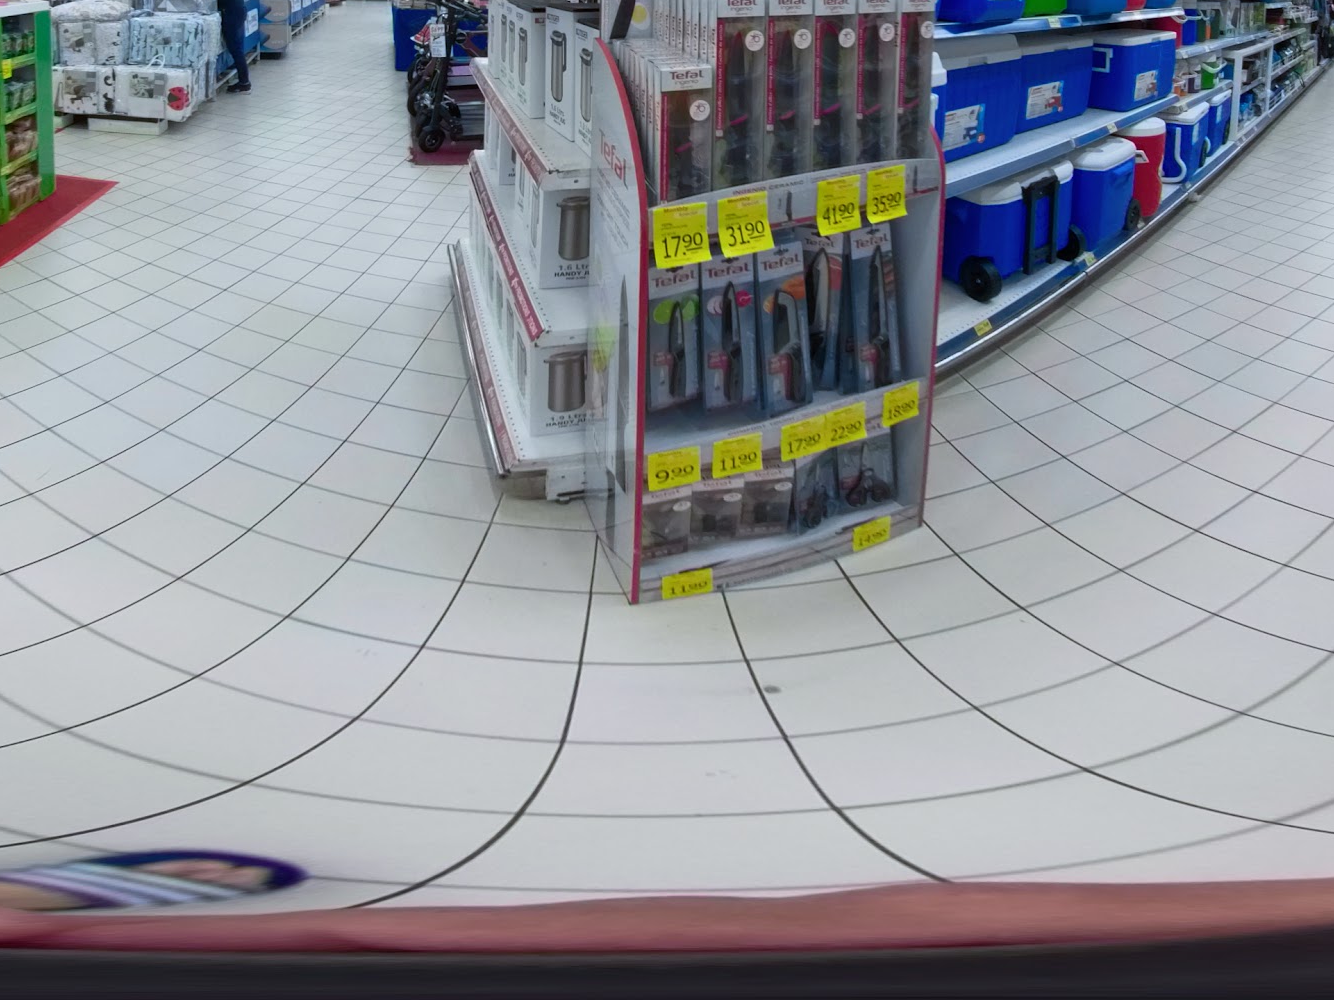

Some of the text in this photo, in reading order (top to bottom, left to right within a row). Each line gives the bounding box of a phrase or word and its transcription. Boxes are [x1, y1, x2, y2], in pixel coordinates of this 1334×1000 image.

[669, 70, 704, 80] Tefal
[598, 128, 629, 191] Tefal
[822, 201, 855, 226] 41.90
[871, 191, 902, 215] 35.90
[725, 220, 765, 248] 31.90
[854, 233, 889, 249] Tefal
[661, 231, 704, 260] 17.90
[705, 262, 752, 278] Tefal
[760, 252, 801, 271] Tefal
[554, 270, 582, 278] HANDY
[652, 270, 696, 289] Tefal
[545, 418, 573, 428] HANDY
[830, 420, 862, 443] 22.90
[786, 432, 821, 454] 17.90
[719, 451, 758, 472] 11.90
[654, 464, 695, 485] 9.90
